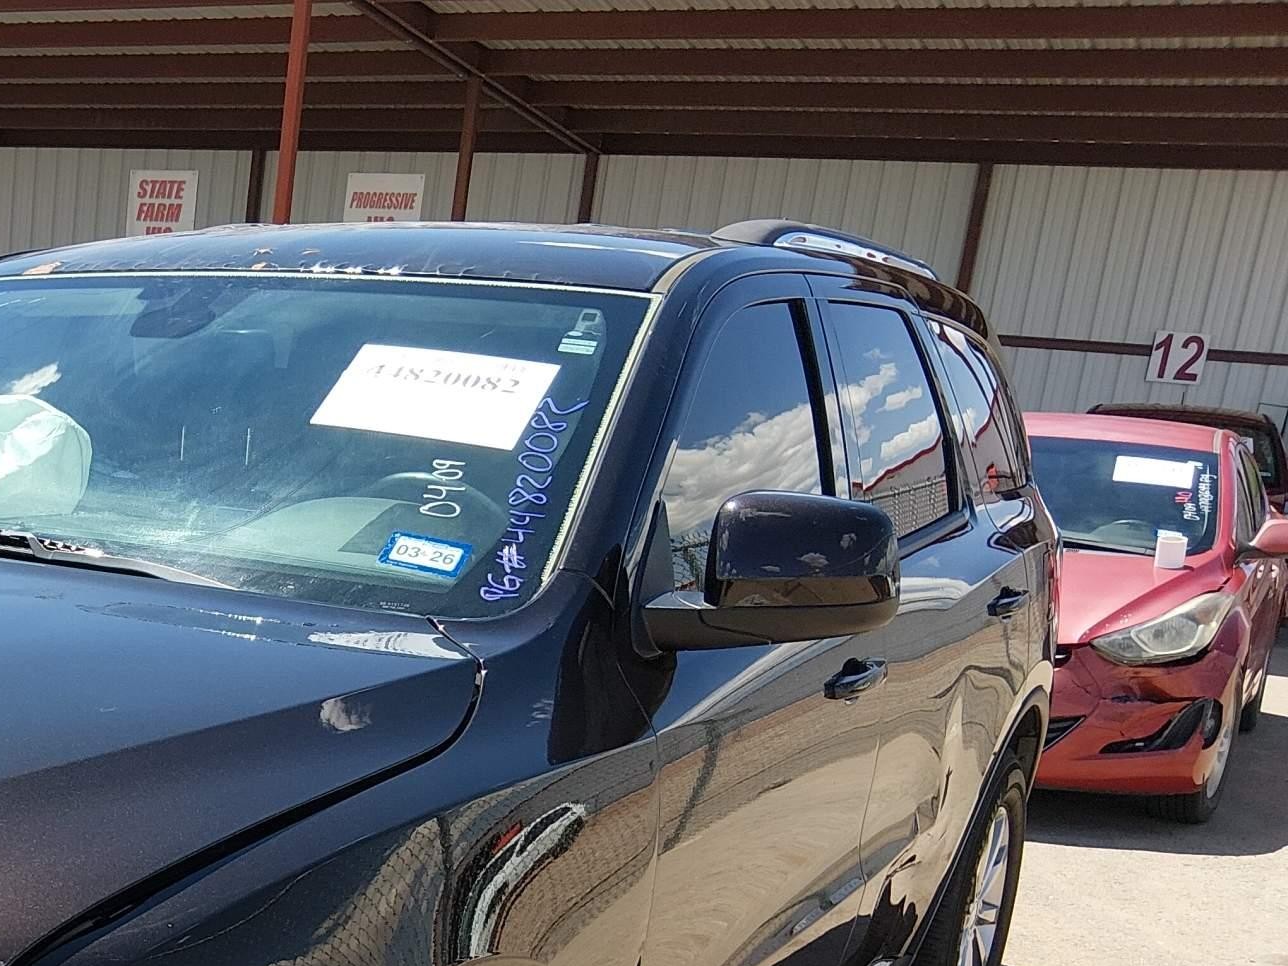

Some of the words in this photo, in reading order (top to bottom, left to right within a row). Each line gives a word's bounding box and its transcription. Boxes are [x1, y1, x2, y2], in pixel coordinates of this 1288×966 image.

[137, 179, 186, 199] STATE
[349, 191, 418, 210] PROGRESSIVE
[136, 202, 183, 222] FARM
[1154, 333, 1205, 381] 12
[419, 458, 466, 518] 0409
[396, 544, 421, 558] 03
[429, 550, 455, 565] 26
